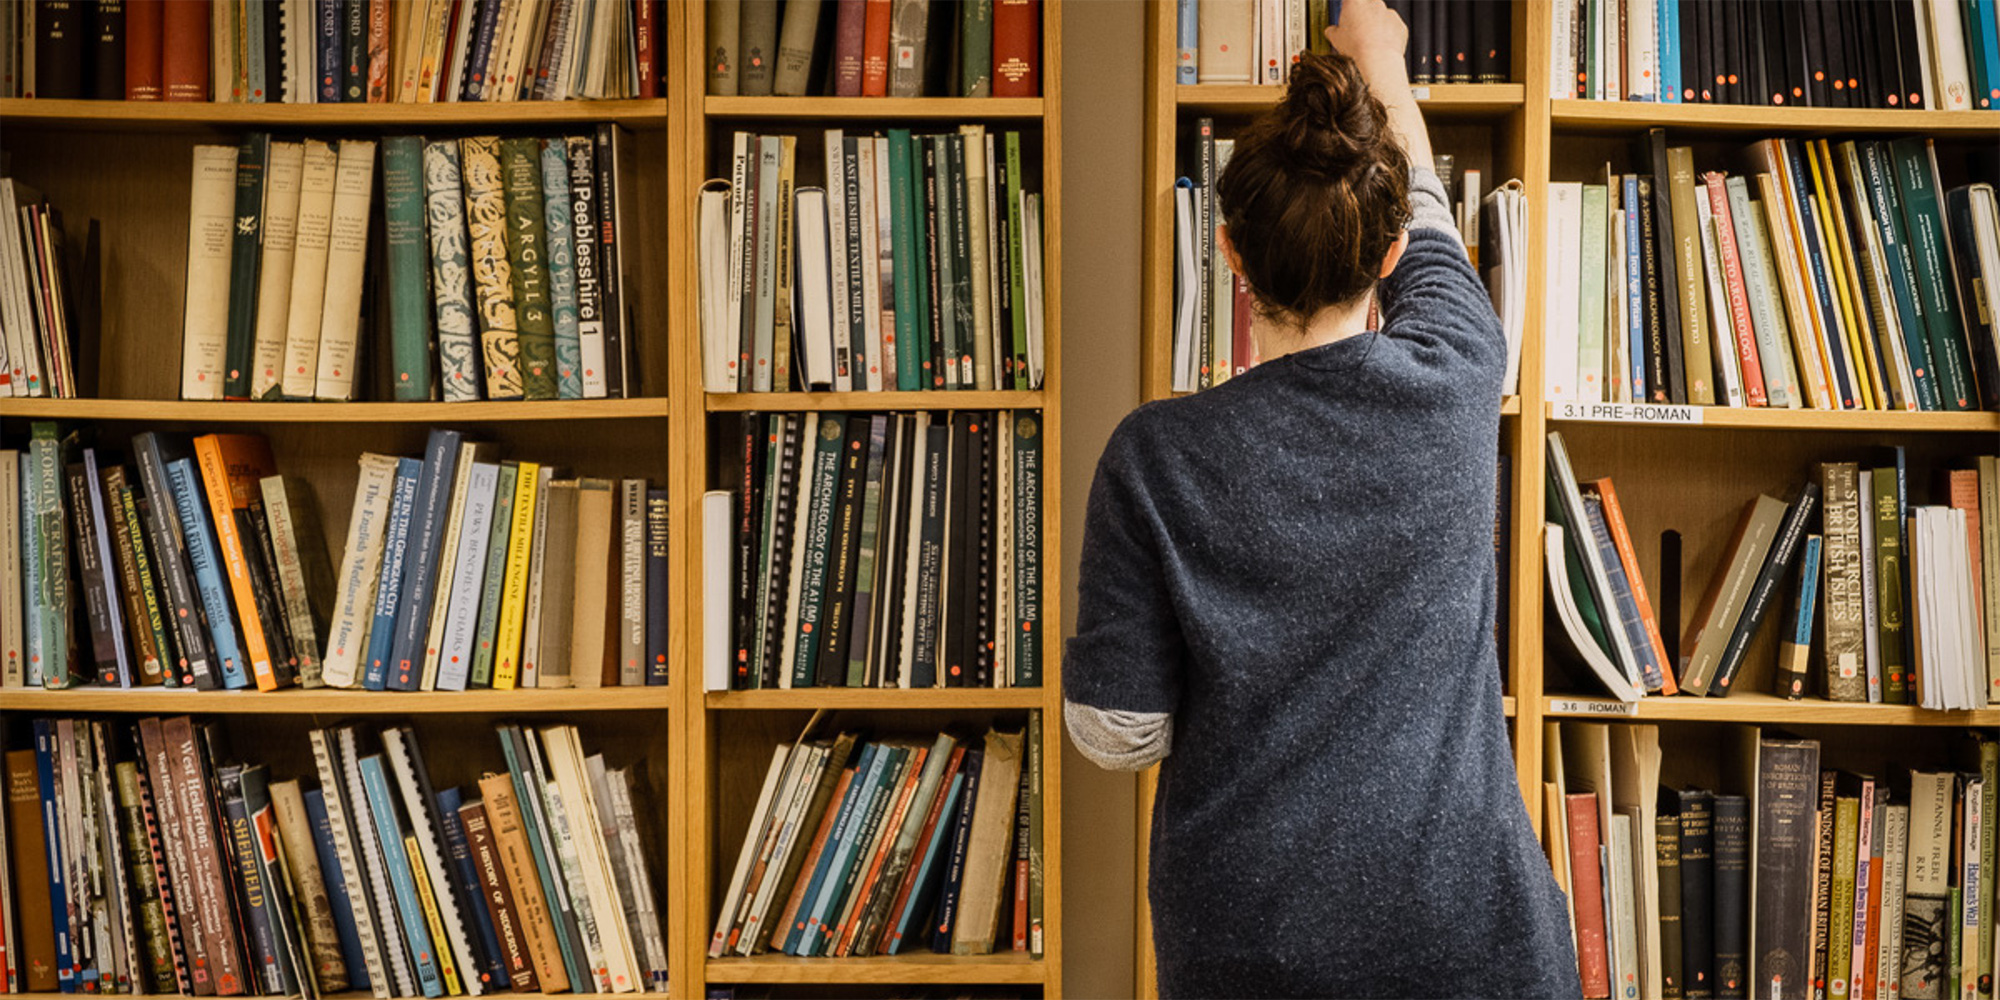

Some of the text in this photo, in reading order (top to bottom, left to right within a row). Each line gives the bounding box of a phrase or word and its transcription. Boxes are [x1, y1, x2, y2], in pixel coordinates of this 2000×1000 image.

[734, 154, 746, 214] Potworks
[1202, 140, 1210, 261] ENGLAND'S WORLD HERITAGE
[1866, 146, 1889, 225] TRANSECT THROUGH
[744, 188, 755, 296] SALISBURY CATHEDRAL
[845, 155, 863, 325] EAST CHESHIRE TEXTILE MILLS
[1642, 208, 1654, 238] SHORT
[518, 216, 543, 322] ARGYLL 3
[552, 219, 573, 326] ARGYLL 4
[573, 186, 599, 337] Peeblesshire 1
[1644, 240, 1655, 275] HISTORY
[1712, 194, 1754, 362] APPROACHES TO ARCHAEOLOGY
[1629, 255, 1641, 329] Iron Age Britain
[1648, 290, 1661, 356] ARCHAEOLOGY
[1752, 281, 1774, 349] ARCHAEOLOGY
[1564, 404, 1691, 421] 3.1 PRE-ROMAN
[629, 484, 638, 516] WELLS
[813, 451, 825, 498] DARRINGTON
[1017, 450, 1025, 496] DARRINGTON
[1828, 484, 1837, 503] THE
[106, 472, 137, 592] Victorian Architecture
[170, 468, 208, 573] TERRACOTTA REVIVAL
[203, 451, 242, 579] Legacies First World War
[270, 501, 298, 567] Endangered
[384, 478, 417, 617] LIFE THE GEORGIAN CITY
[386, 495, 402, 551] CRUICKSHANK
[510, 471, 532, 601] THE TEXTILE MILL ENGINE
[805, 451, 837, 623] THE ARCHAEOLOGY OF THE A1 (M)
[1025, 450, 1037, 621] THE ARCHAEOLOGY OF THE A1 (M)
[1828, 504, 1844, 571] BRITISH
[1843, 469, 1862, 623] THE STONE CIRCLES
[50, 519, 65, 609] CRAFTSMEN
[126, 510, 162, 631] CASTLES GROUND
[344, 483, 380, 617] The English Mediaeval
[624, 520, 634, 620] KNITWEAR INDUSTRY
[632, 520, 642, 645] THE BRITISH HOSIERY AND
[203, 586, 217, 629] STRATTON
[452, 540, 480, 652] BENCHES CHAIRS
[917, 570, 929, 647] LEAD SMELTING
[1831, 577, 1846, 621] ISLES
[1023, 633, 1032, 679] LANCASTER
[1588, 703, 1626, 713] ROMAN
[180, 740, 195, 776] West
[860, 759, 883, 804] The Buildings
[179, 782, 189, 815] Christine
[186, 778, 210, 849] Heslerton:
[834, 812, 851, 840] ENGLAND
[1861, 786, 1872, 846] English Heritage
[1930, 777, 1945, 882] BRITANNIA FRERE
[1970, 789, 1979, 851] English Heritage
[1983, 760, 1995, 879] Roman Britain from the air
[157, 751, 203, 954] West Heslerton: The Anglian Cemetery Volume
[232, 817, 264, 908] SHEFFIELD
[1018, 815, 1029, 859] OF TOWTON
[1816, 780, 1834, 950] THE LANDSCAPE OF ROMAN BRITAIN
[1885, 812, 1895, 879] CUNLIFFE THE
[205, 872, 216, 898] Anglian
[479, 846, 498, 888] HISTORY
[493, 891, 504, 905] OF
[1834, 891, 1842, 909] THE
[1854, 860, 1869, 946] Roman Britain
[1966, 862, 1979, 926] Hadrian's Wall
[210, 899, 222, 932] Cemetery
[1831, 910, 1841, 977] AGRIMENSORES
[1841, 894, 1851, 961] INTRODUCTION
[1893, 883, 1903, 941] TRINOVANTES
[218, 939, 228, 966] Volume
